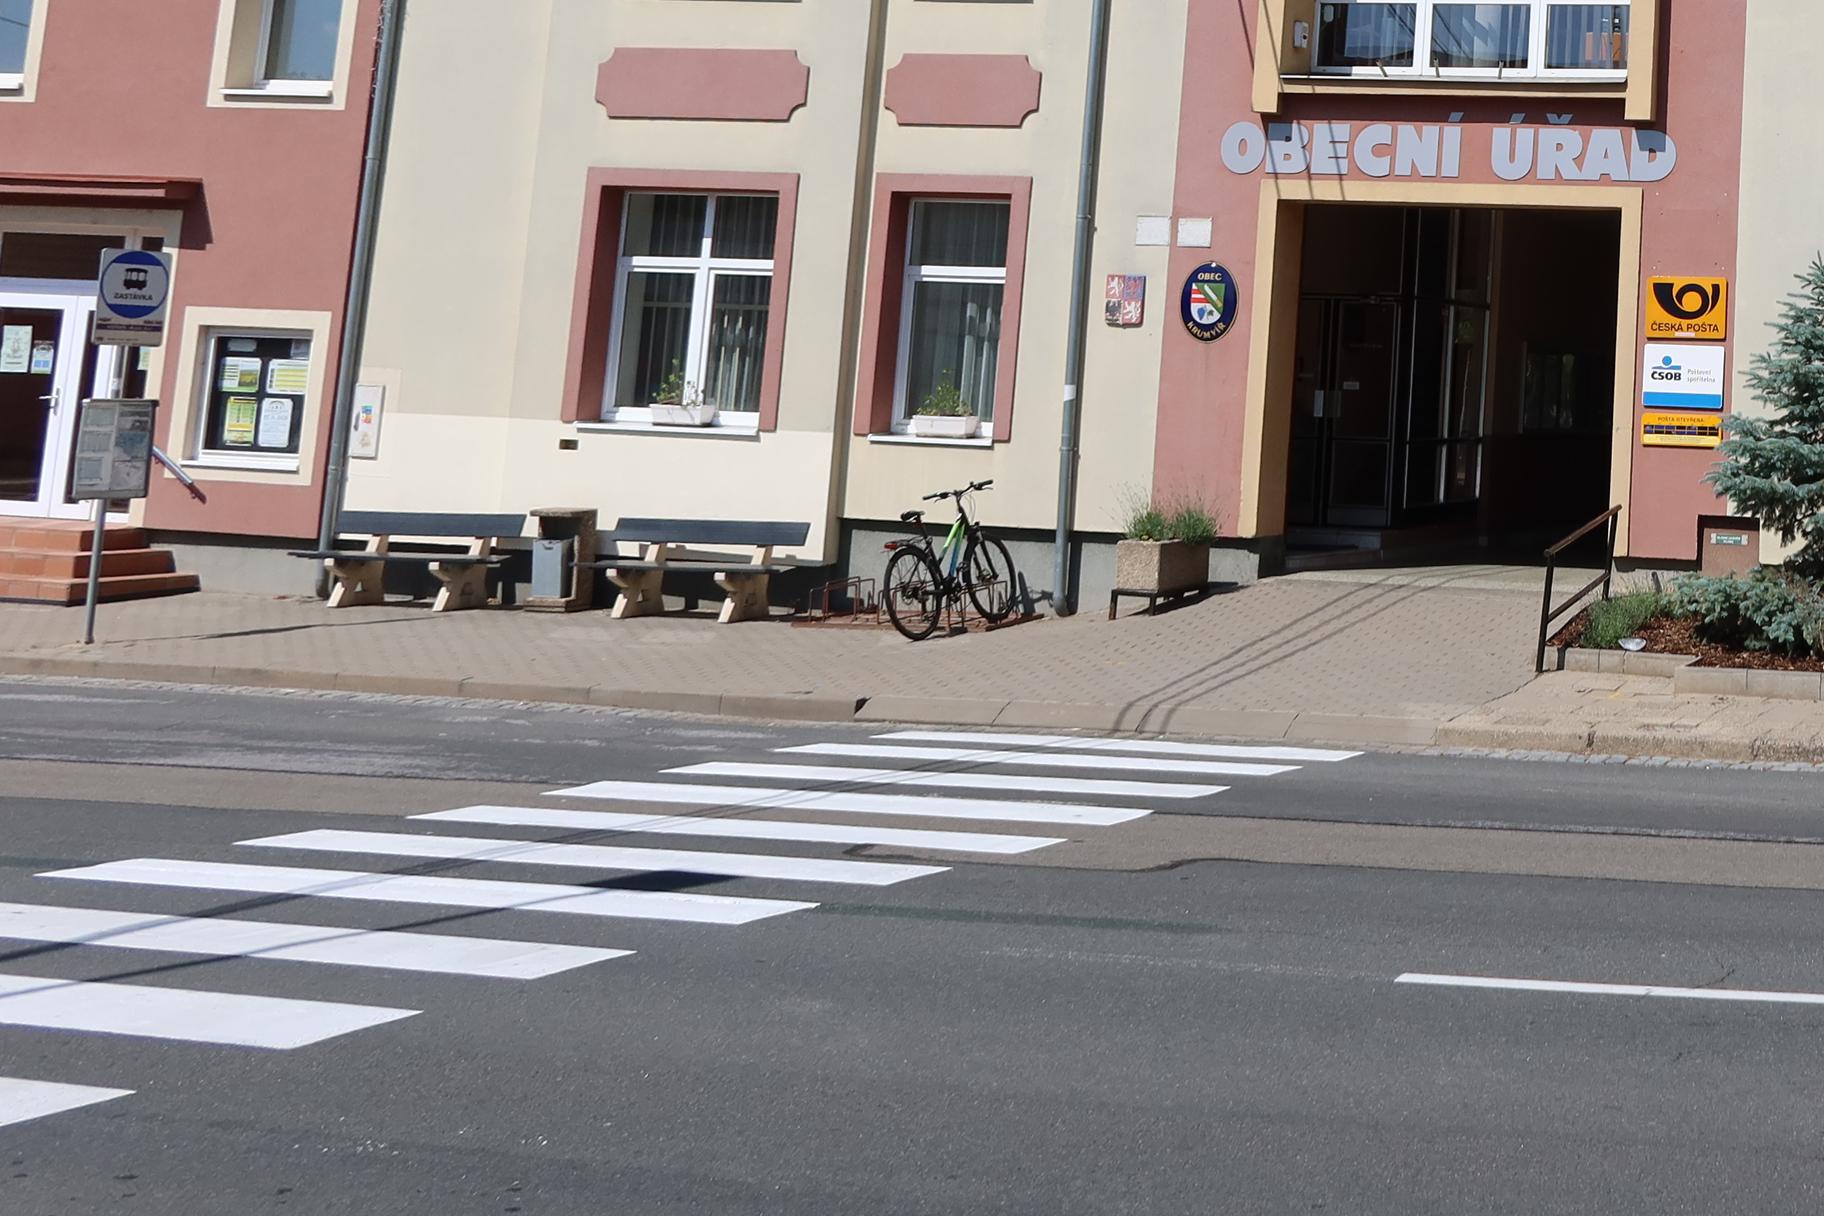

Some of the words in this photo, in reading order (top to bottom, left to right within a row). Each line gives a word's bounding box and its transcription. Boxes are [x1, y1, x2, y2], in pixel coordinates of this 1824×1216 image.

[1220, 112, 1465, 178] OBECNÍ
[1491, 113, 1677, 182] ÚŘAD
[1197, 272, 1222, 281] OBEC
[113, 292, 153, 301] ZASTÁVKA
[1187, 321, 1226, 339] KRUMVÍŘ
[1651, 321, 1683, 332] ČESKÁ
[1686, 322, 1719, 333] POŠTA
[1651, 371, 1682, 381] ČSOB
